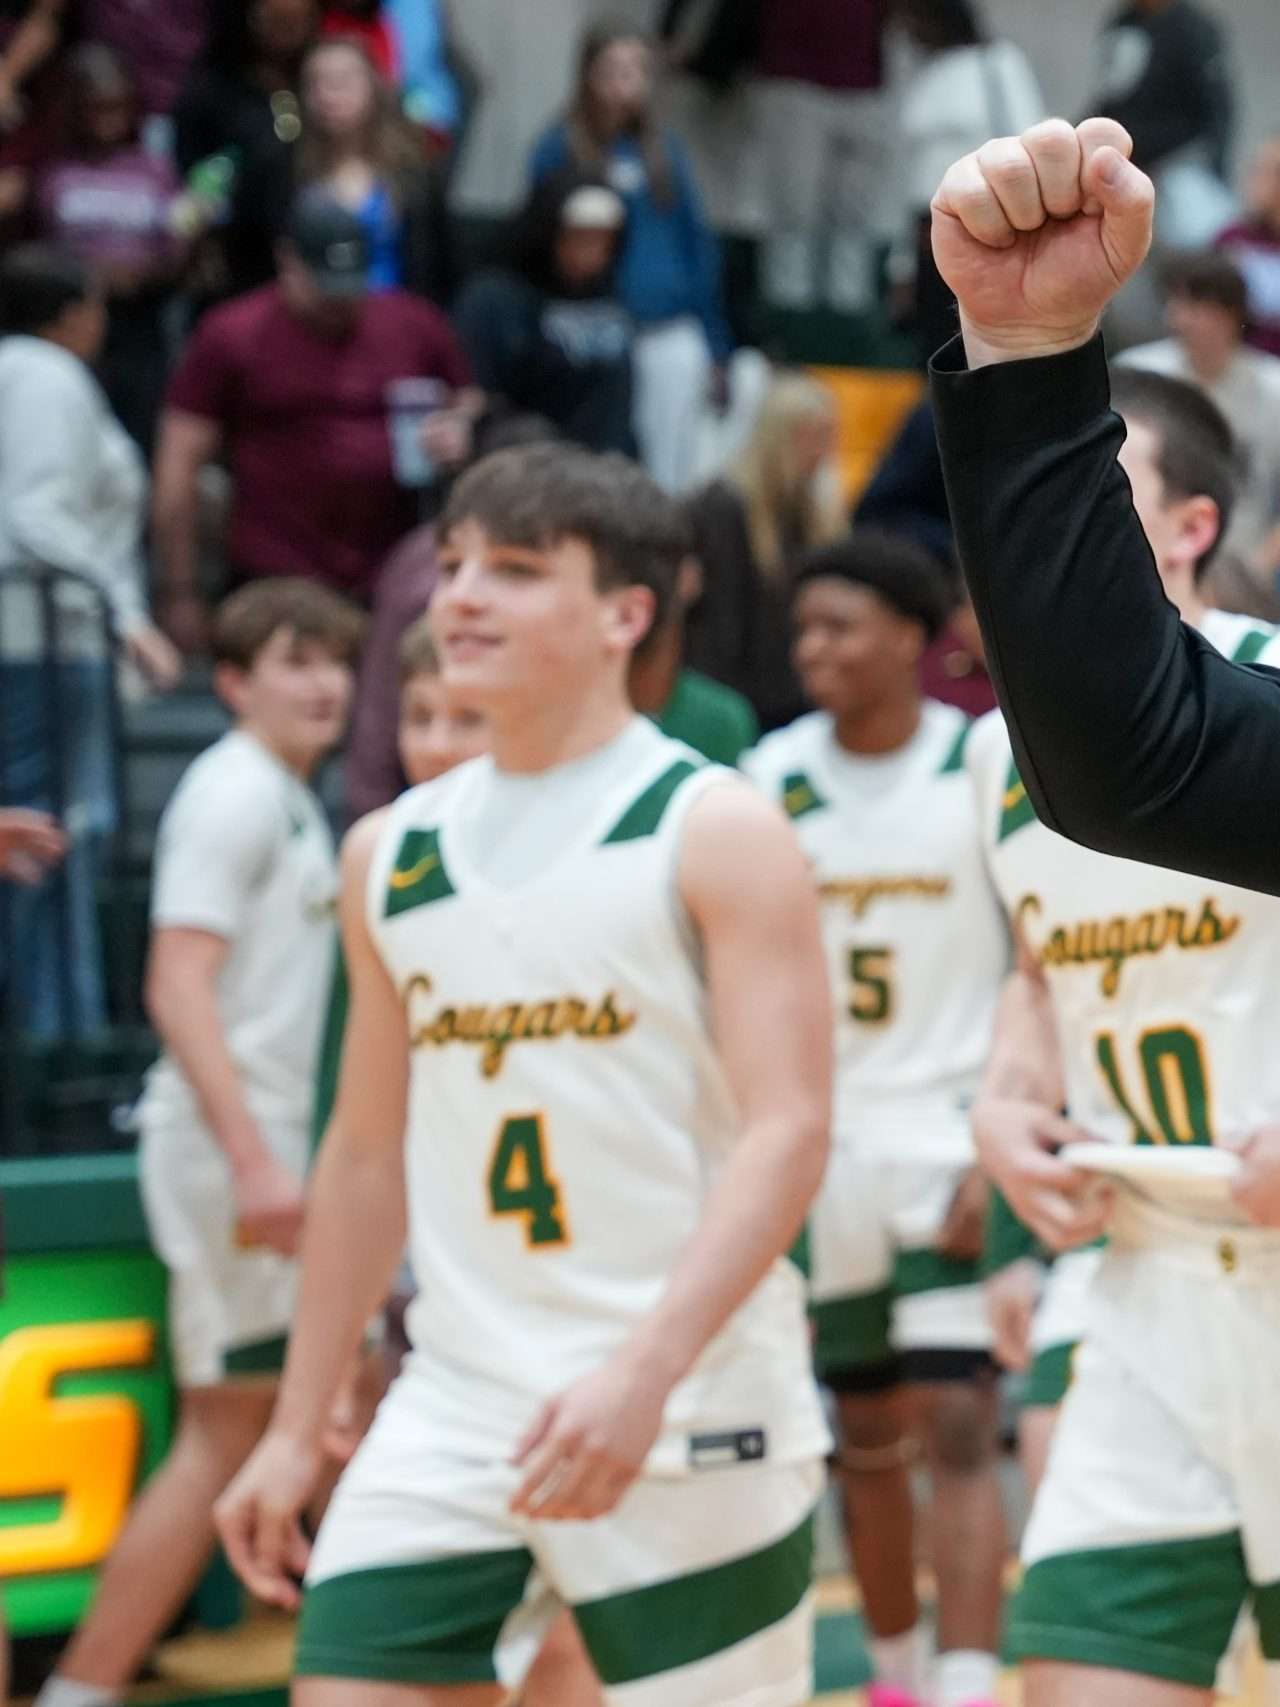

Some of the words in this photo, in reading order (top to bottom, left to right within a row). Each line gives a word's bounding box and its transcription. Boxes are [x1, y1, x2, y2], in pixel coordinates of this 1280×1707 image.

[847, 945, 893, 1026] 5
[1096, 1024, 1215, 1146] 10
[486, 1112, 572, 1253] 4
[0, 1318, 154, 1577] S
